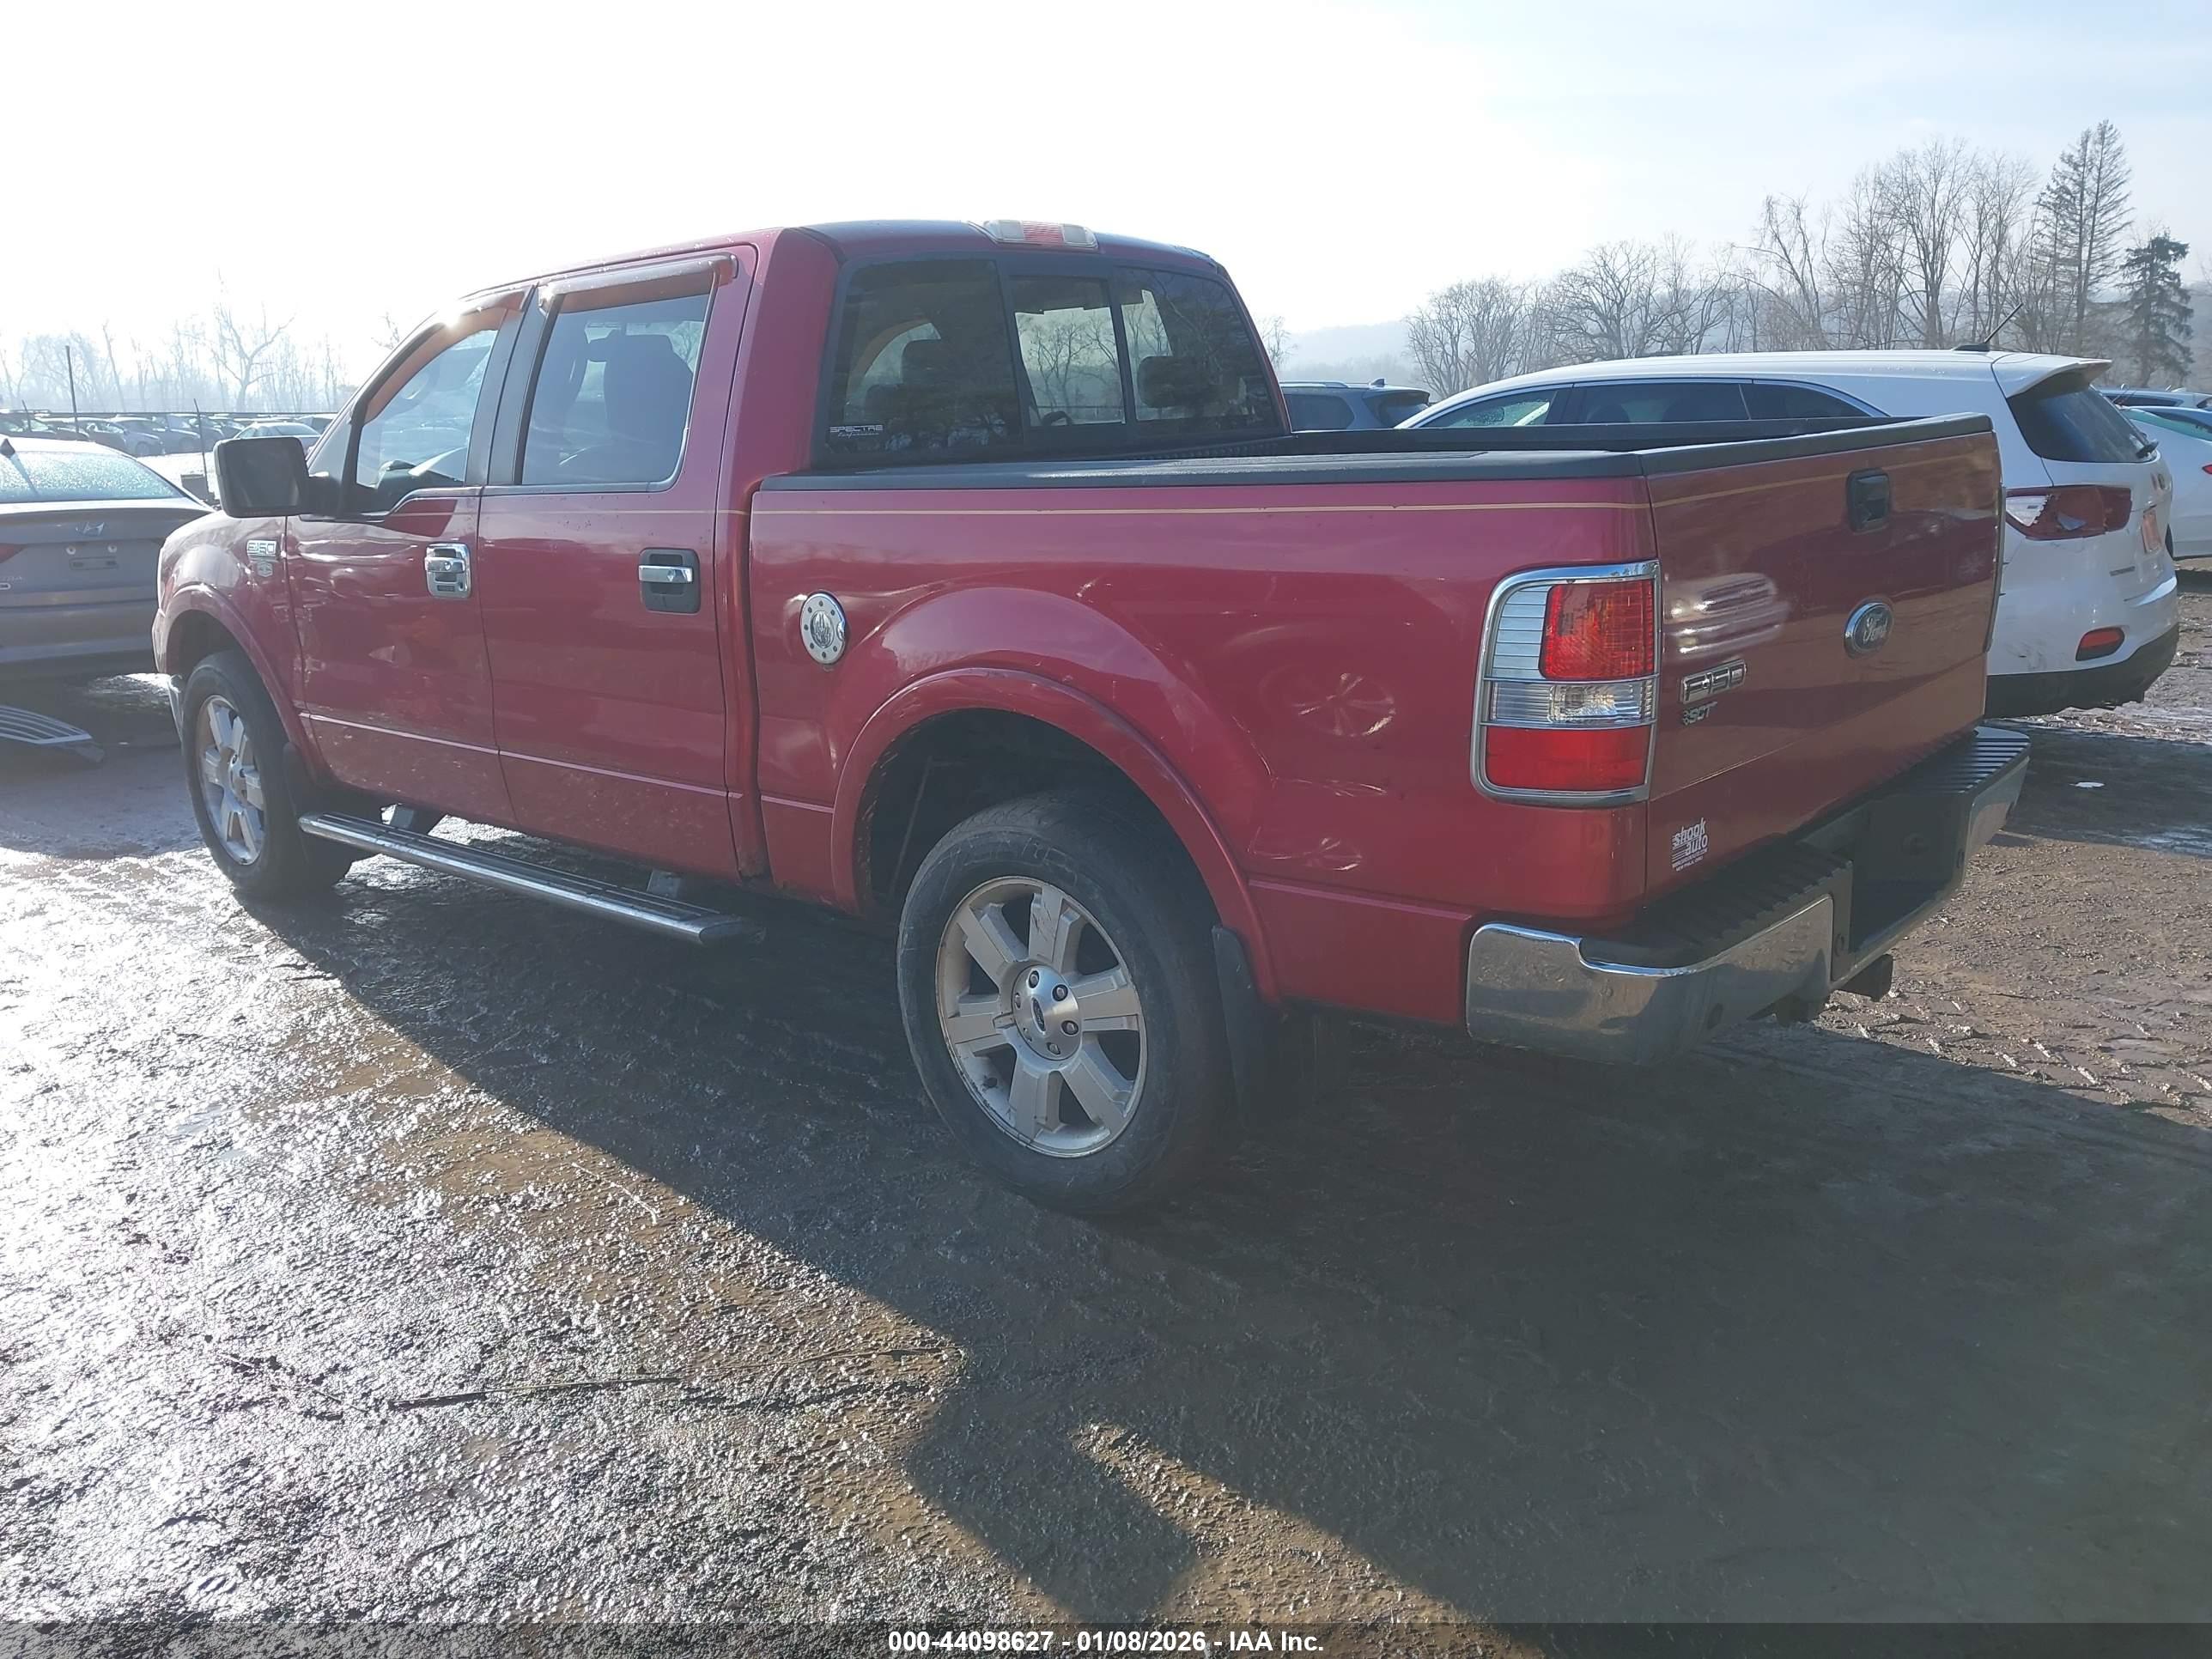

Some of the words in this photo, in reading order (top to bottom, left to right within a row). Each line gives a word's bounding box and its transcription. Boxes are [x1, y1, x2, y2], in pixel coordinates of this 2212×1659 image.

[1863, 617, 1888, 644] Ford
[1674, 817, 1706, 847] shook
[1685, 834, 1708, 856] auto
